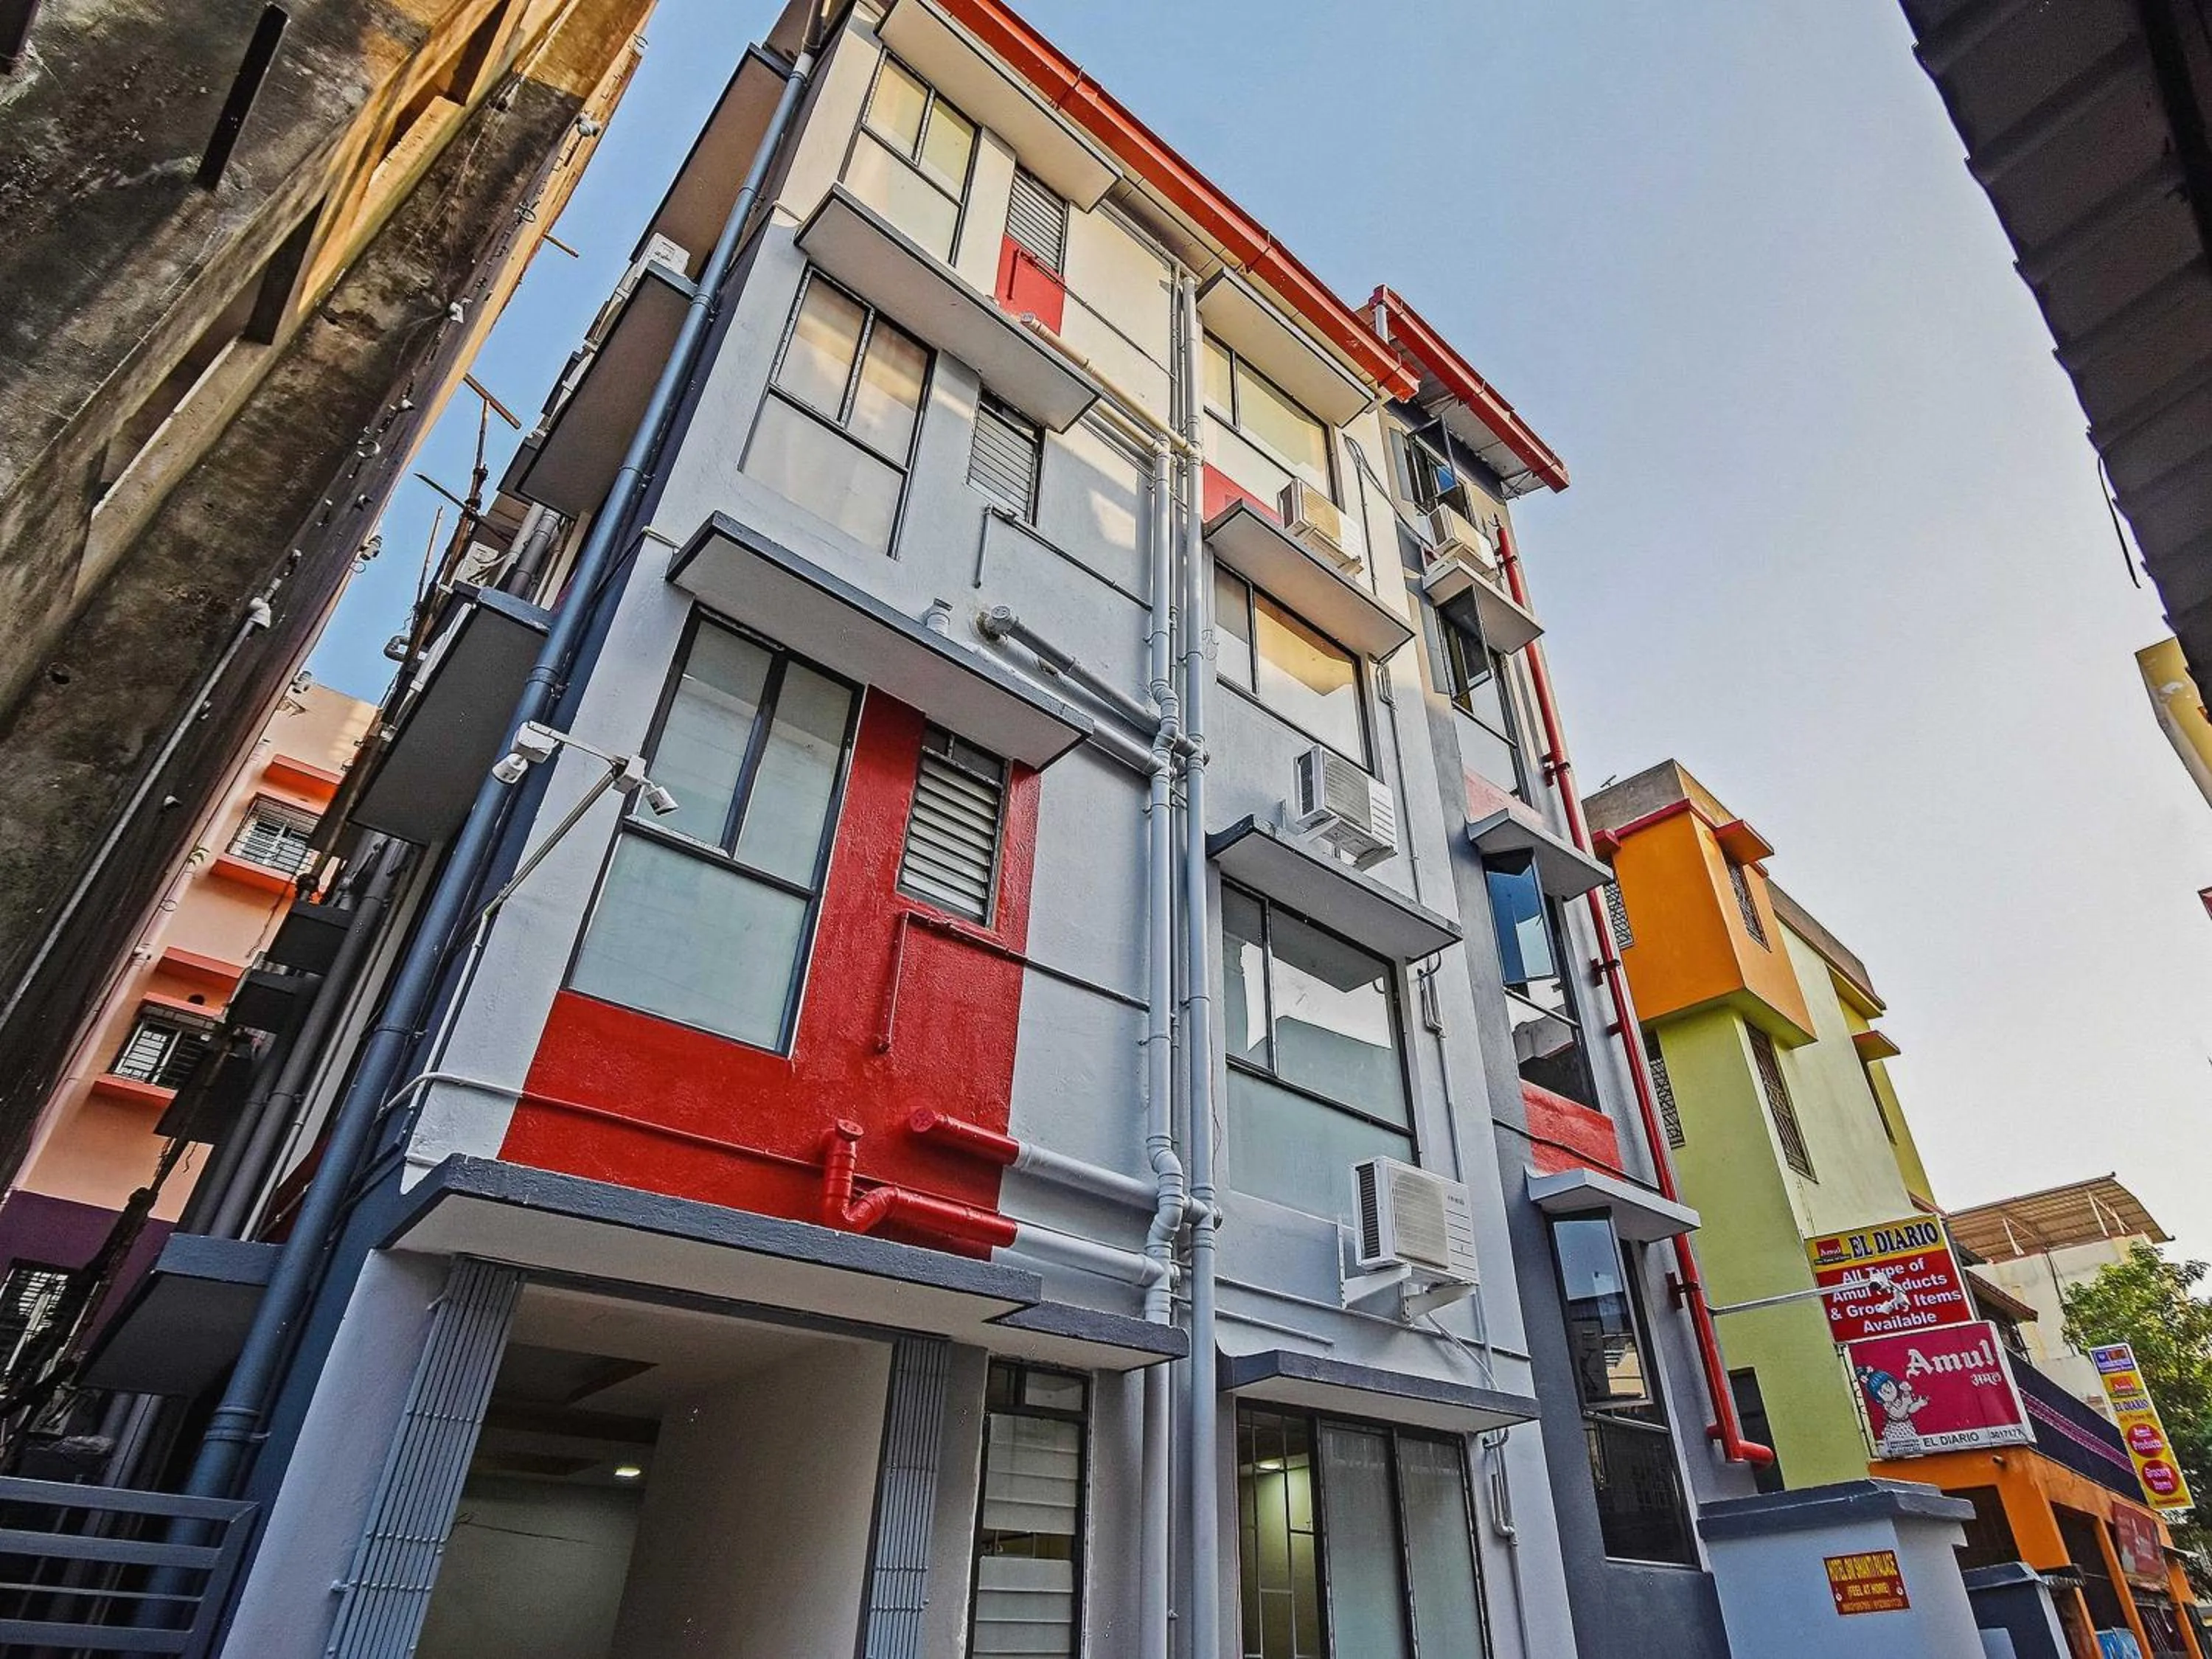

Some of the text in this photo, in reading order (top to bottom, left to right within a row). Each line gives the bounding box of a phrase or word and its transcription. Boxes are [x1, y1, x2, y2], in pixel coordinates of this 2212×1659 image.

[1848, 1221, 1939, 1258] EL DIARIO
[1843, 1270, 1863, 1285] All
[1909, 1257, 1925, 1272] of
[1831, 1308, 1843, 1321] &
[1913, 1290, 1962, 1307] Items
[1832, 1287, 1871, 1303] Amul
[1863, 1312, 1937, 1334] Available
[1906, 1338, 1996, 1379] Amul
[1923, 1436, 1939, 1447] EL
[1941, 1431, 1980, 1446] DIARIO
